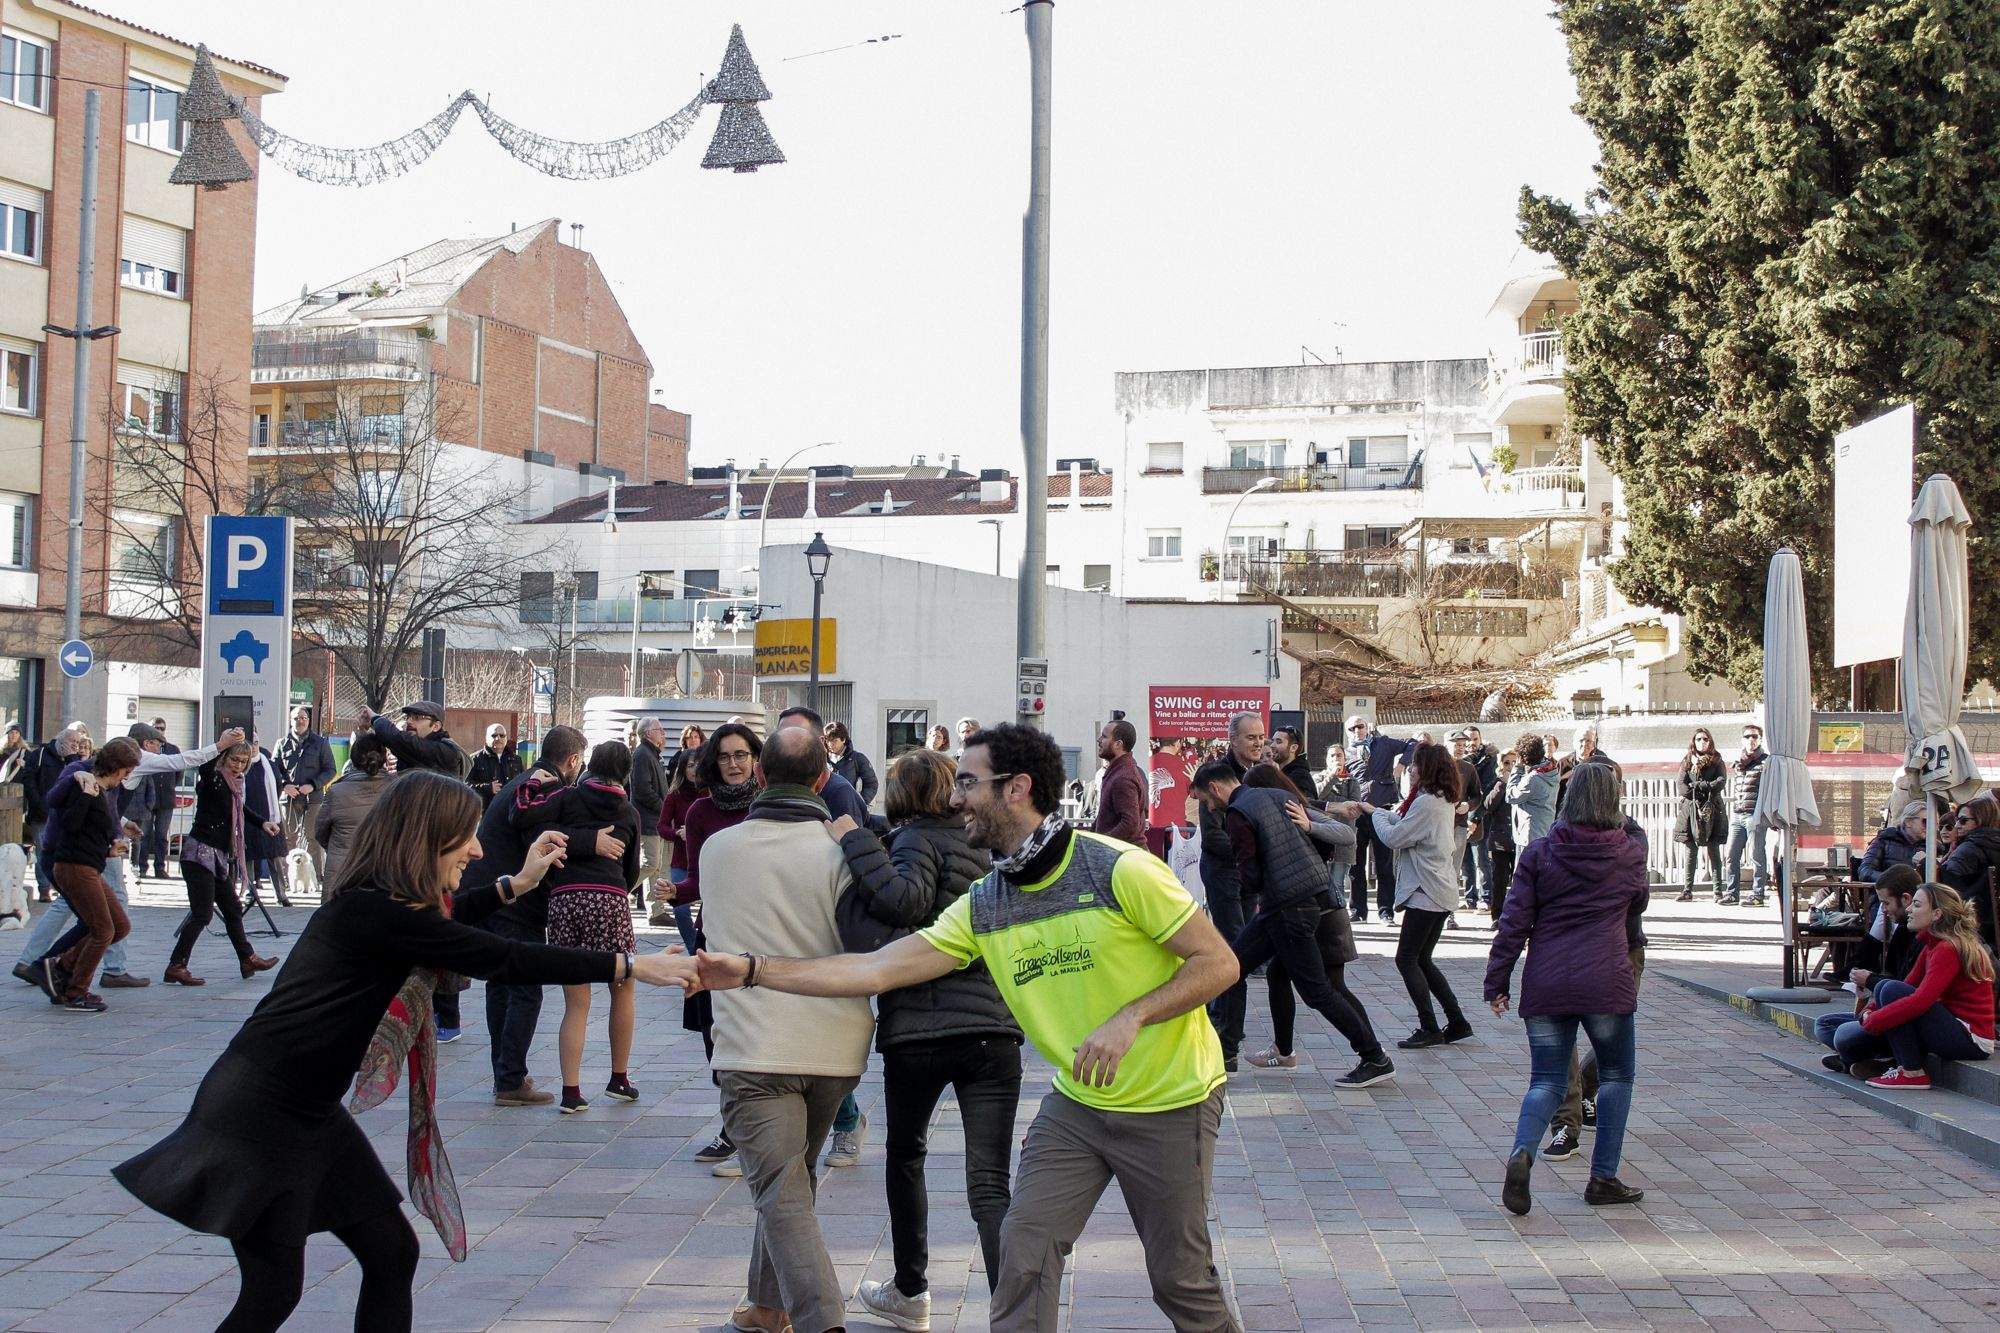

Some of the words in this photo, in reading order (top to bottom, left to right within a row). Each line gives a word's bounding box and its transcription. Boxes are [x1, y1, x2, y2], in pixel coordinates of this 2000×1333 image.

[227, 535, 267, 588] P
[755, 660, 811, 675] PLANAS
[1154, 696, 1202, 709] SWING
[1206, 700, 1216, 709] al
[1220, 700, 1263, 710] carrer
